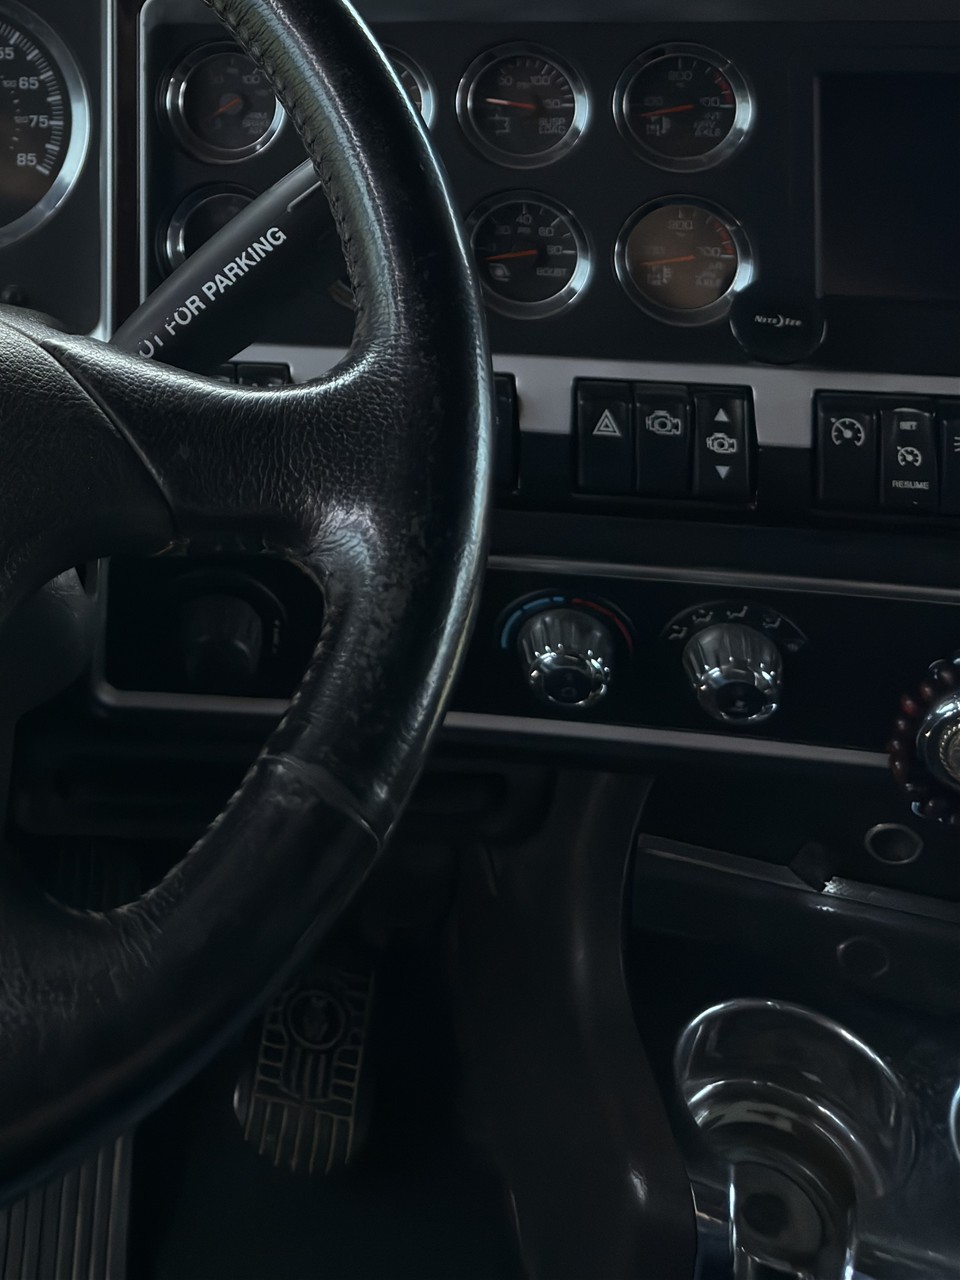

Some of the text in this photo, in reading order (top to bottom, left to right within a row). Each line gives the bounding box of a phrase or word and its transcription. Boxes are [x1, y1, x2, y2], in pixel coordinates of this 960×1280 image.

[18, 76, 40, 90] 65
[28, 115, 49, 128] 75
[16, 152, 37, 166] 85
[515, 214, 533, 224] 40
[538, 227, 555, 237] 60
[165, 295, 207, 336] FOR
[201, 227, 288, 302] PARKING
[891, 479, 930, 490] RESUME
